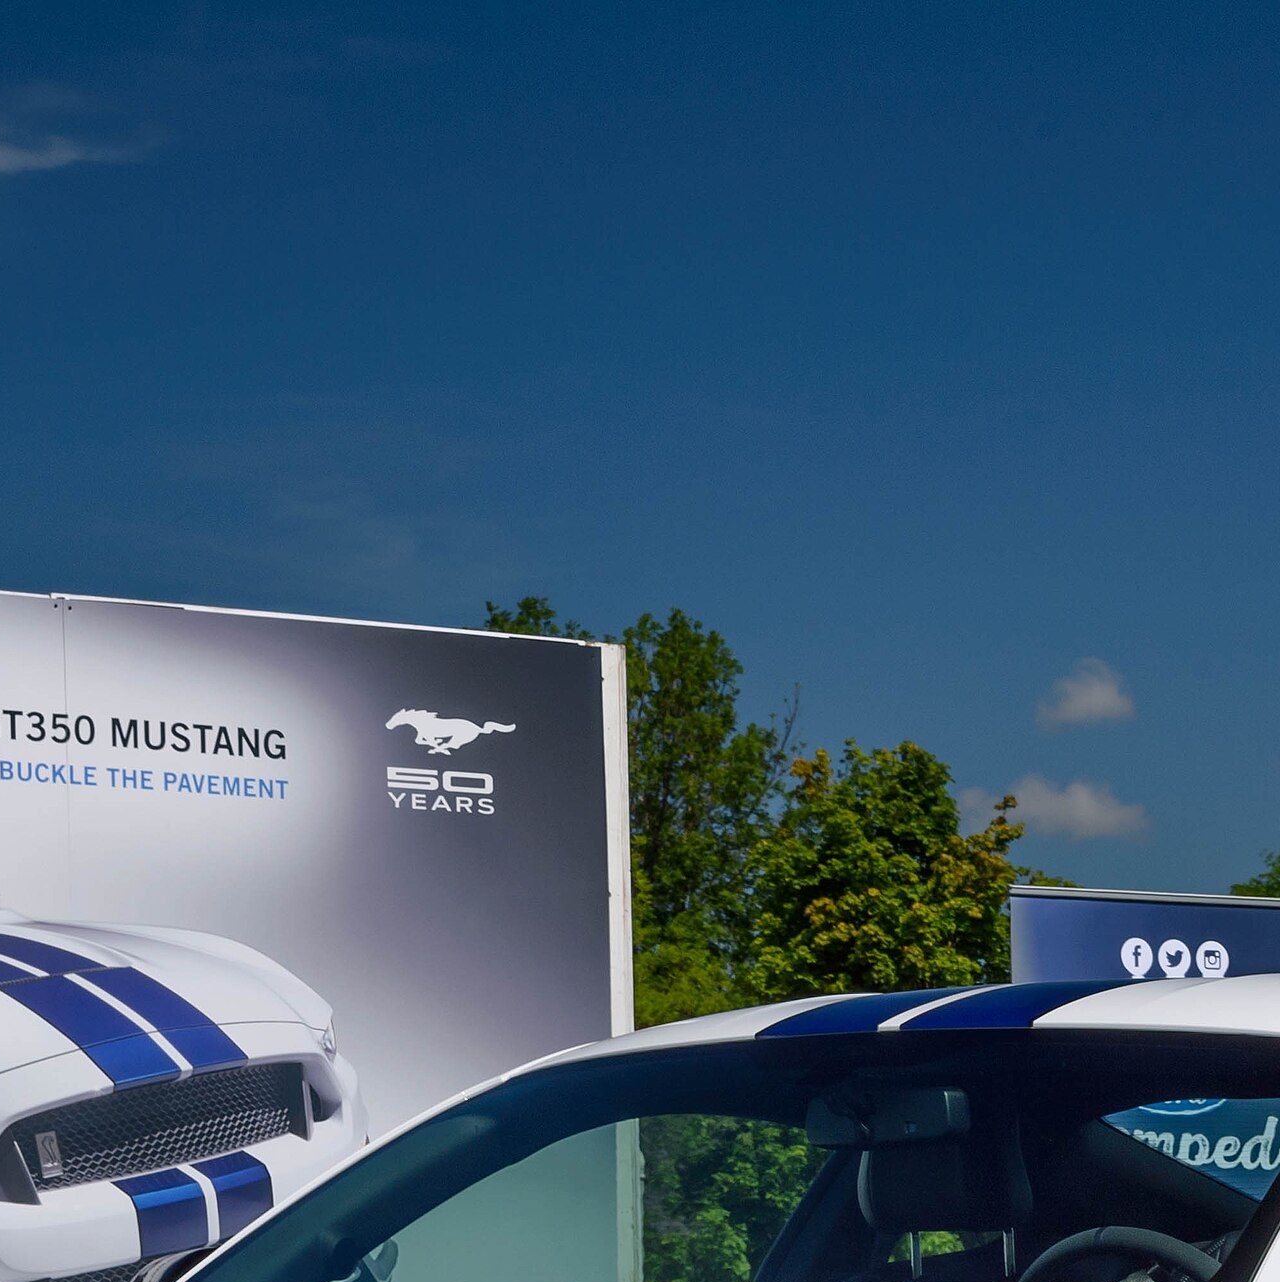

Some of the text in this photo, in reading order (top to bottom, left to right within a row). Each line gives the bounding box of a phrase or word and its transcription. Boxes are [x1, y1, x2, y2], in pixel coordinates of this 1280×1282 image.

[110, 717, 287, 760] MUSTANG
[0, 760, 98, 787] BUCKLE
[106, 767, 154, 791] THE
[163, 772, 290, 800] PAVEMENT
[386, 766, 494, 795] 50
[387, 791, 495, 815] YEARS
